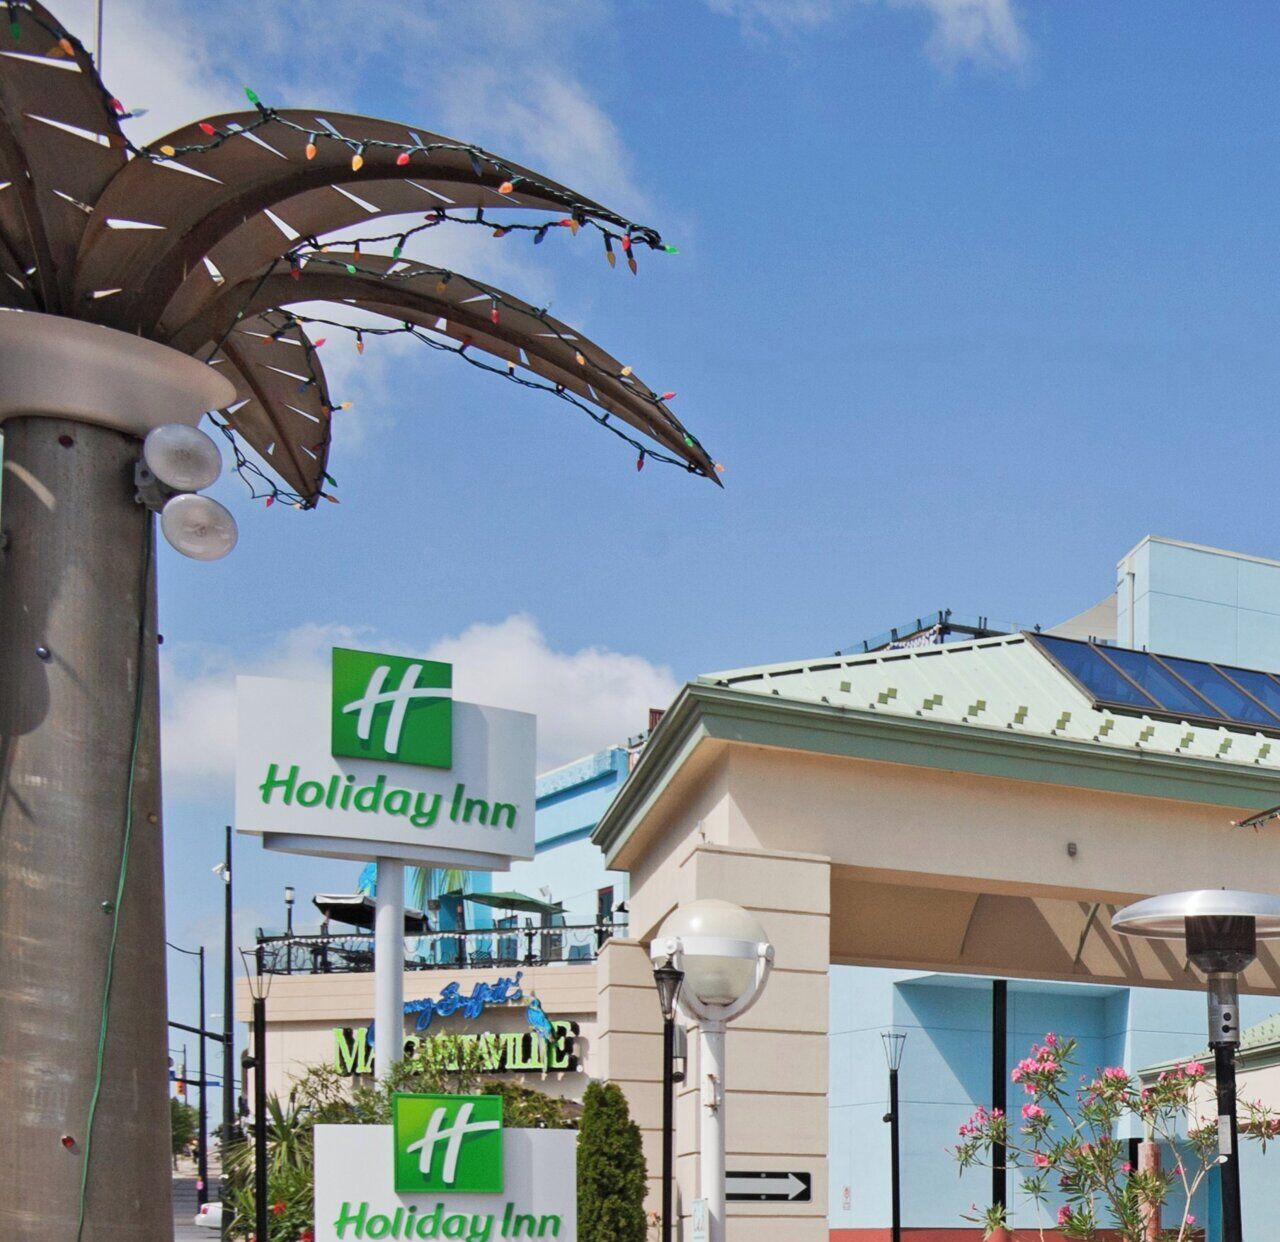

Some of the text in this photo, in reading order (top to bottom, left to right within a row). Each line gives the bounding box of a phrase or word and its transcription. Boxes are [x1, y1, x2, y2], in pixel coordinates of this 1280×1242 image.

[259, 763, 517, 830] Holiday Inn
[501, 1202, 561, 1238] Inn
